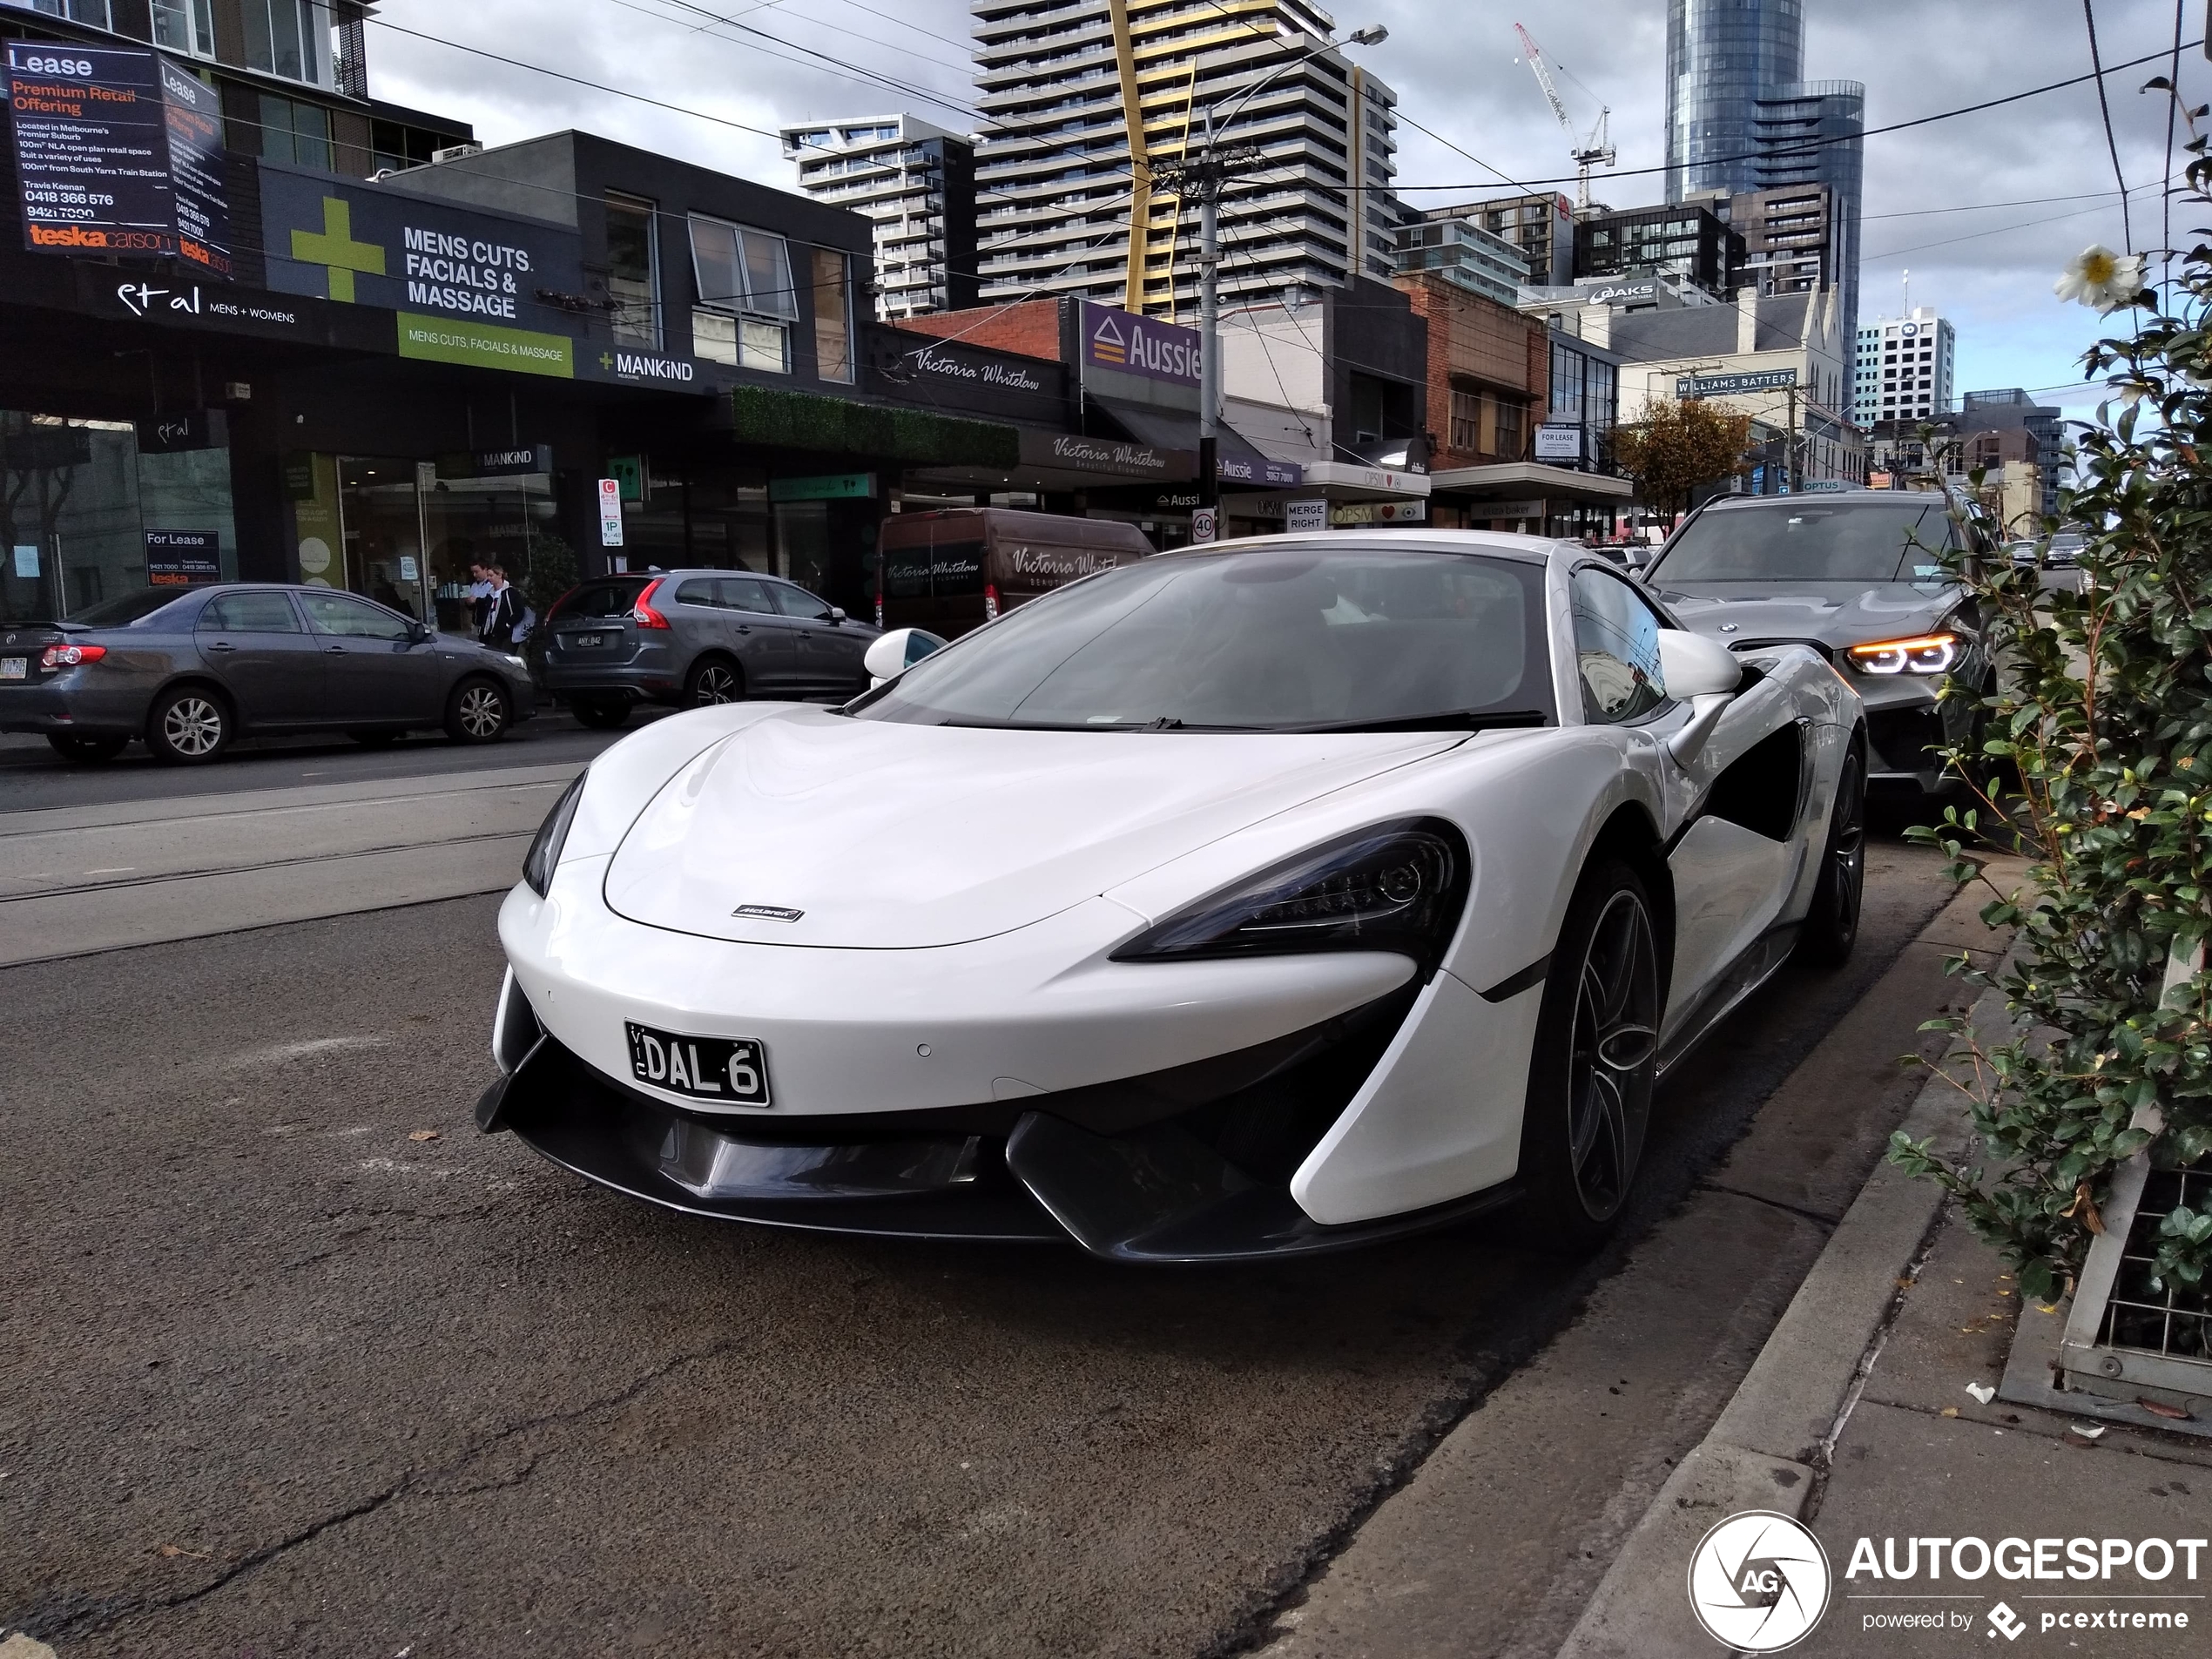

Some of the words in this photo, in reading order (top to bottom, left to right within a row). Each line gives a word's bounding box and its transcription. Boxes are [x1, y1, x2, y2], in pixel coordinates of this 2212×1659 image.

[9, 50, 92, 76] Lease
[12, 80, 86, 99] Premium
[90, 87, 136, 103] Retail
[161, 64, 196, 106] Lease
[14, 97, 82, 117] Offering
[17, 121, 50, 131] Located
[60, 125, 109, 135] Melbourne's
[17, 130, 49, 139] Premier
[51, 132, 81, 141] Suburb
[44, 152, 72, 162] variety
[52, 182, 84, 191] Keenan
[24, 191, 57, 202] 0418
[60, 193, 86, 204] 366
[89, 194, 114, 206] 576
[26, 206, 57, 218] 9421
[189, 222, 203, 238] 7000
[404, 226, 469, 260] MENS
[406, 253, 497, 291] FACIALS
[502, 273, 517, 294] &
[408, 280, 516, 319] MASSAGE
[210, 303, 238, 316] MENS
[249, 307, 295, 324] WOMENS
[1903, 325, 1915, 334] 10
[409, 330, 438, 344] MENS
[440, 334, 469, 349] CUTS,
[470, 338, 510, 354] FACIALS
[511, 344, 518, 355] &
[519, 346, 563, 361] MASSAGE
[1130, 325, 1201, 380] Aussie
[915, 349, 977, 378] Victoria
[981, 364, 1040, 390] Whitelaw
[1678, 379, 1736, 392] WLLIAMS
[1742, 374, 1795, 387] BATTERS
[1053, 437, 1109, 461] Victoria
[1113, 445, 1165, 468] Whitelaw
[1224, 460, 1252, 479] Aussie
[1804, 481, 1838, 490] OPTUS
[1170, 493, 1200, 506] Aussi
[1289, 505, 1324, 515] MERGE
[1332, 508, 1374, 523] OPSM
[1506, 504, 1529, 516] baker
[605, 522, 617, 531] 1P
[1196, 519, 1211, 531] 40
[1291, 518, 1321, 528] RIGHT
[147, 533, 166, 544] For
[169, 534, 204, 545] Lease
[1013, 547, 1074, 574] Victoria
[887, 565, 929, 579] Victoria
[931, 560, 978, 575] Whitelaw
[739, 907, 791, 917] McLaren
